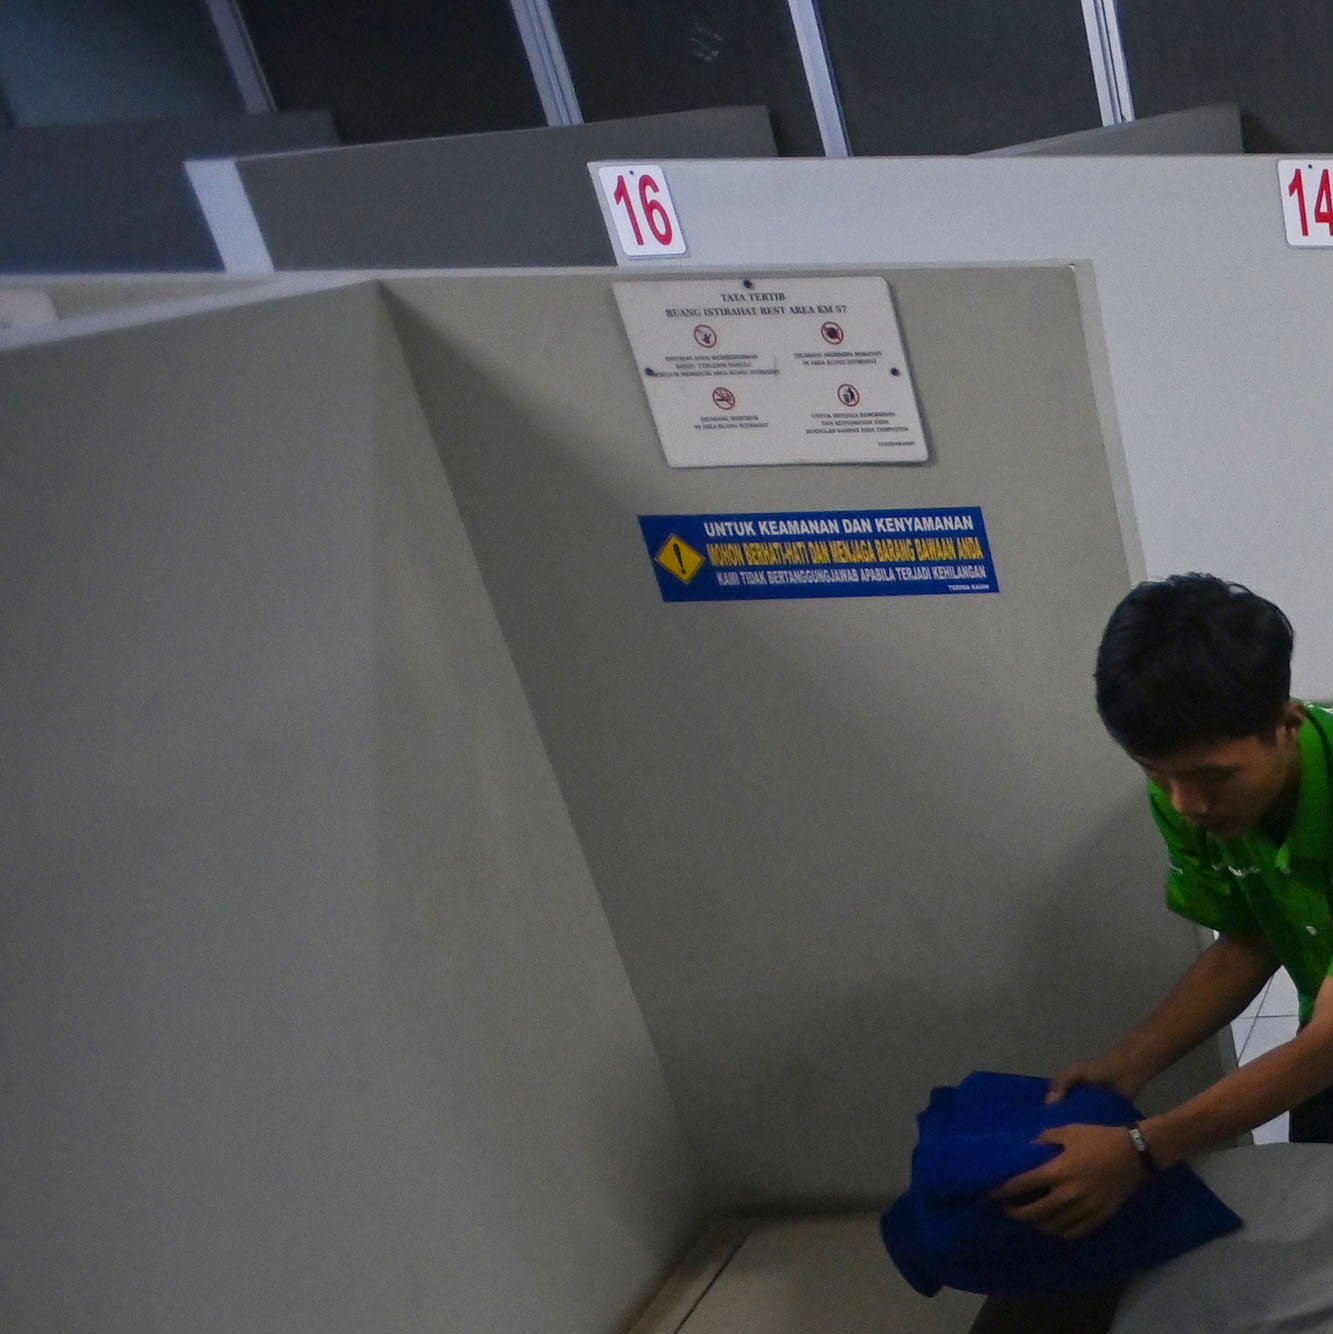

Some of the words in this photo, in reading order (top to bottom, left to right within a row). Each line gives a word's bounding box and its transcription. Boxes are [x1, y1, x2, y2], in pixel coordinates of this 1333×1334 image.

[614, 174, 673, 246] 16
[720, 293, 745, 302] TATA
[750, 292, 786, 301] TERTIB
[665, 308, 701, 318] RUANG
[703, 307, 758, 317] ISTIRAHAT
[760, 306, 785, 316] REST
[789, 306, 815, 315] AREA
[817, 305, 834, 314] KM
[836, 304, 847, 313] 57
[704, 521, 756, 537] UNTUK
[758, 519, 840, 536] KEAMANAN
[842, 518, 873, 533] DAN
[875, 515, 974, 532] KENYAMANAN
[706, 543, 745, 567] MOHON
[743, 541, 810, 566] BERHATI-HATI
[807, 541, 831, 564] DAN
[829, 539, 877, 563] MENJAGA
[874, 538, 916, 562] BARANG
[914, 537, 957, 561] BAWAAN
[956, 536, 984, 559] ANDA
[716, 571, 740, 586] KAMI
[740, 570, 768, 586] TIDAK
[766, 568, 859, 584] BERTANGGUNGJAWAB
[860, 567, 896, 582] APABILA
[895, 566, 933, 581] TERJADI
[931, 565, 987, 580] KEHILANGAN
